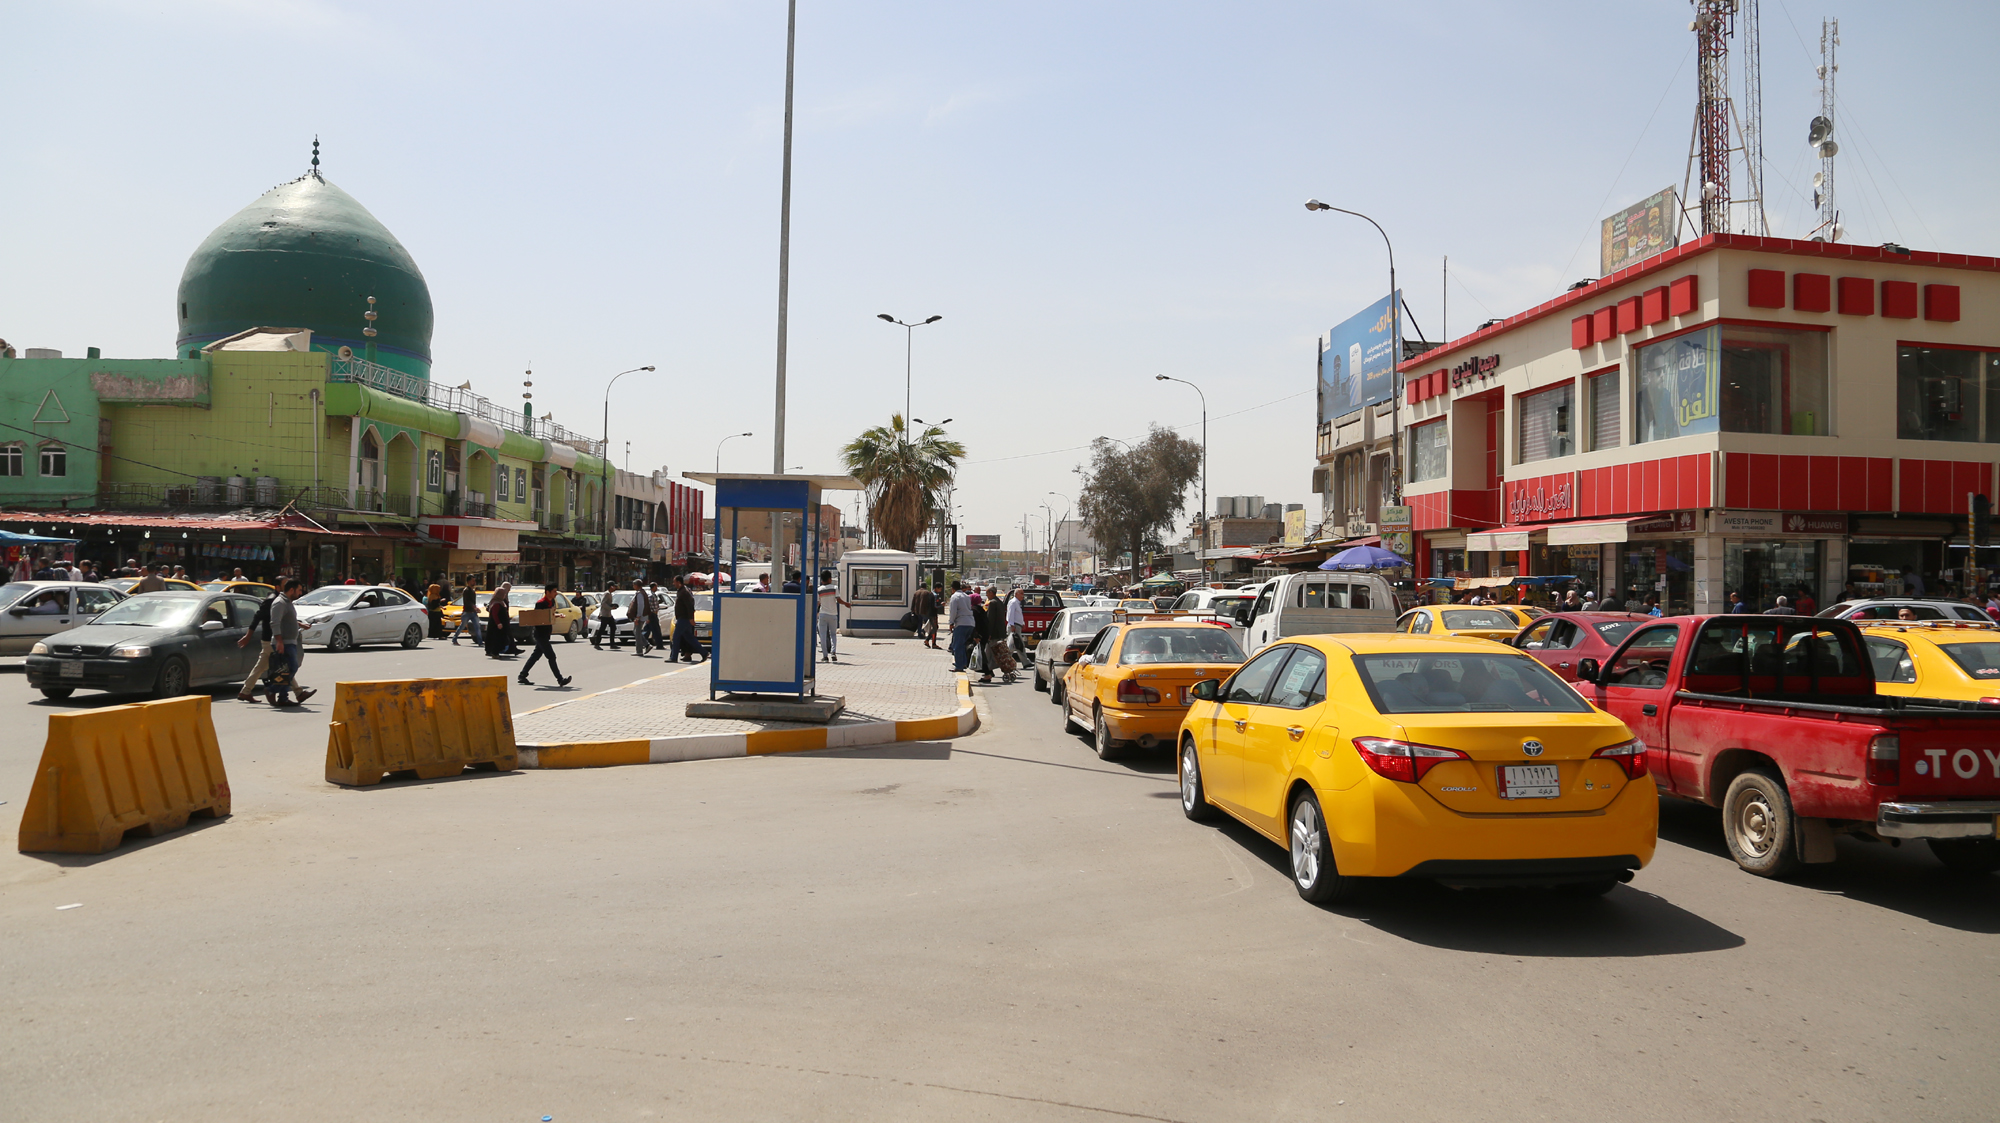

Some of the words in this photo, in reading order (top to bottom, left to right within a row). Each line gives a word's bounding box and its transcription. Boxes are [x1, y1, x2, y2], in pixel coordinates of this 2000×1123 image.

[1478, 354, 1500, 380] مجمع
[1679, 325, 1718, 427] الفن
[1543, 483, 1571, 519] الغدير
[1750, 518, 1773, 526] PHONE
[1808, 521, 1842, 529] HUAWEI
[1599, 622, 1621, 632] 2012
[1382, 660, 1404, 668] KIA
